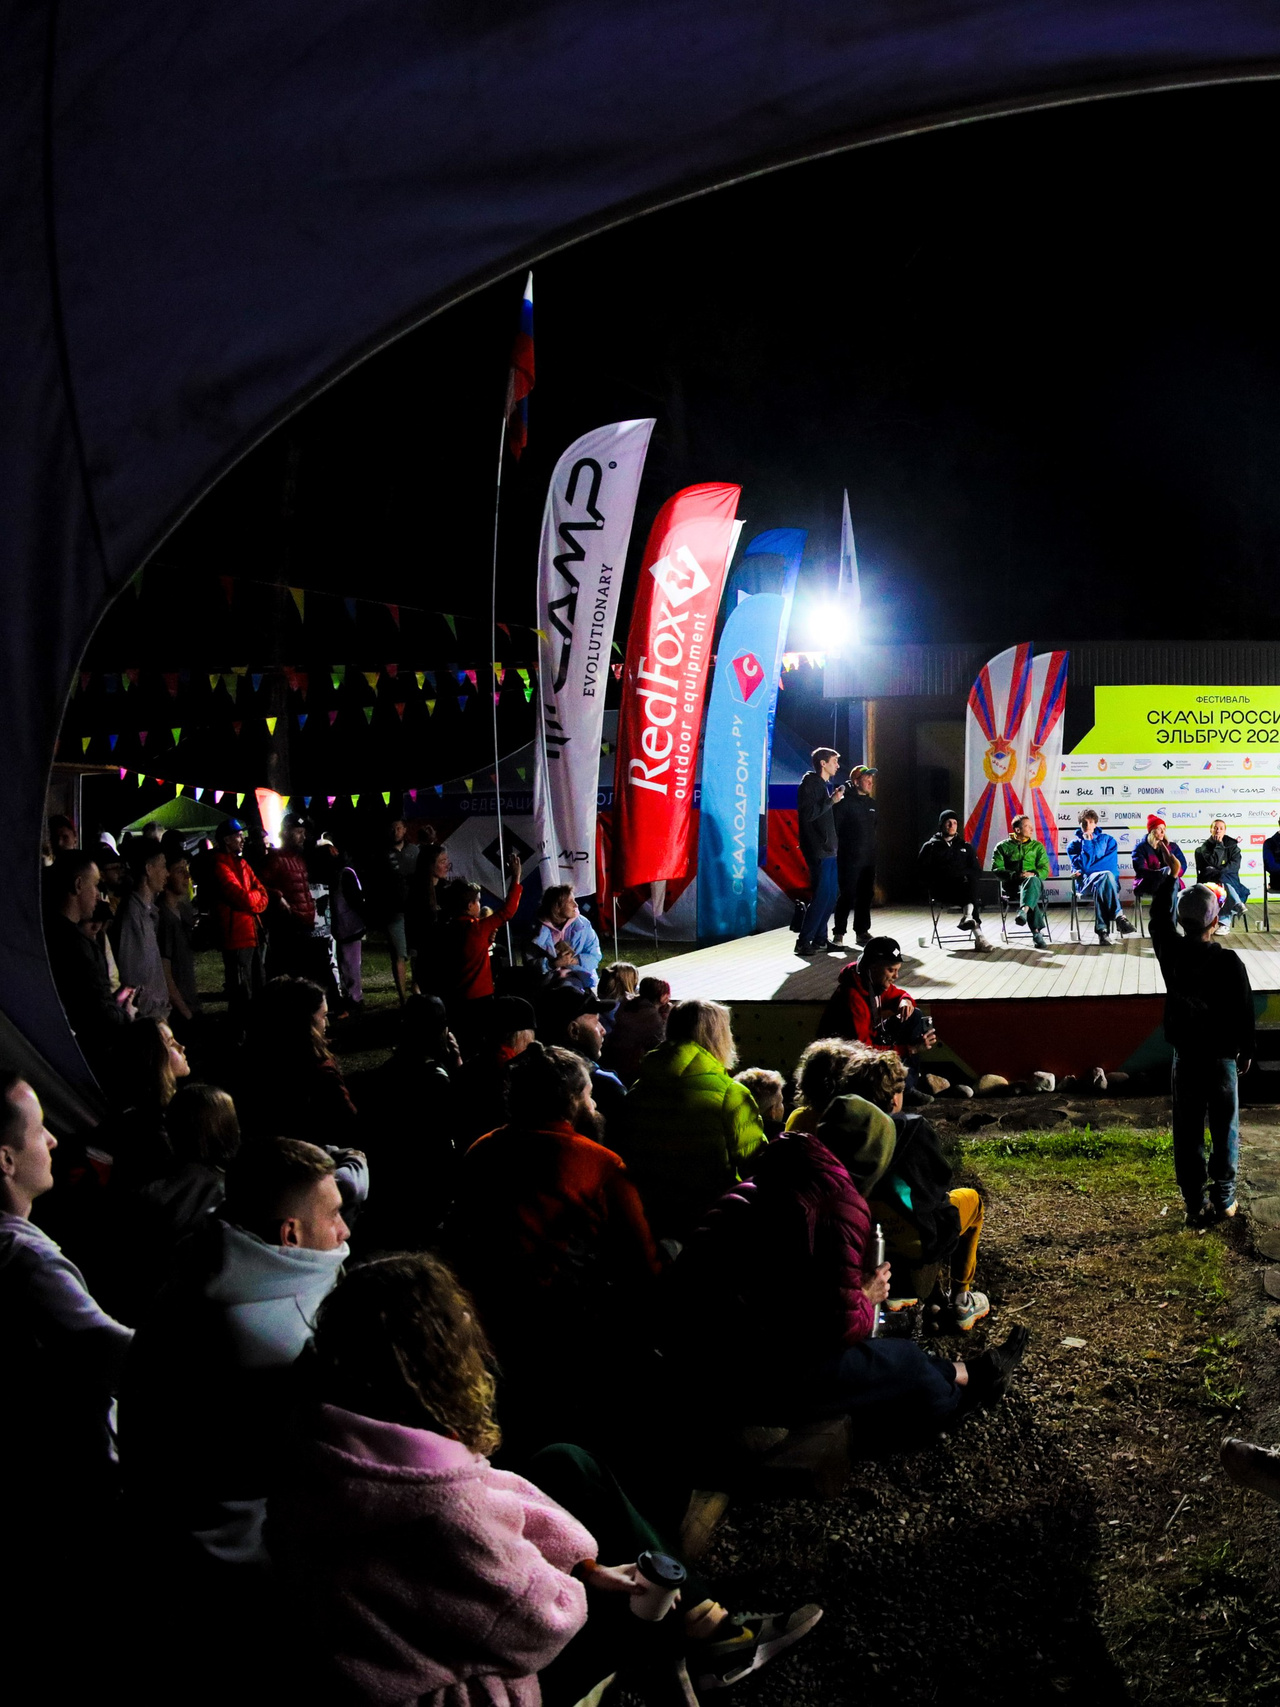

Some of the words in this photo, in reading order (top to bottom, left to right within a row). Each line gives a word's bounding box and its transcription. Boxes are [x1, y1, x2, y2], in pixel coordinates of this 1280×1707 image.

[583, 563, 613, 697] EVOLUTIONARY
[628, 604, 690, 795] RedFox
[674, 723, 692, 799] outdoor
[683, 612, 708, 713] equipment
[1196, 695, 1250, 704] ФЕСТИВАЛЬ
[1147, 710, 1214, 725] СКАЛЫ
[1156, 729, 1242, 744] ЭЛЬБРУС
[460, 796, 534, 812] ФЕДЕРАЦИ
